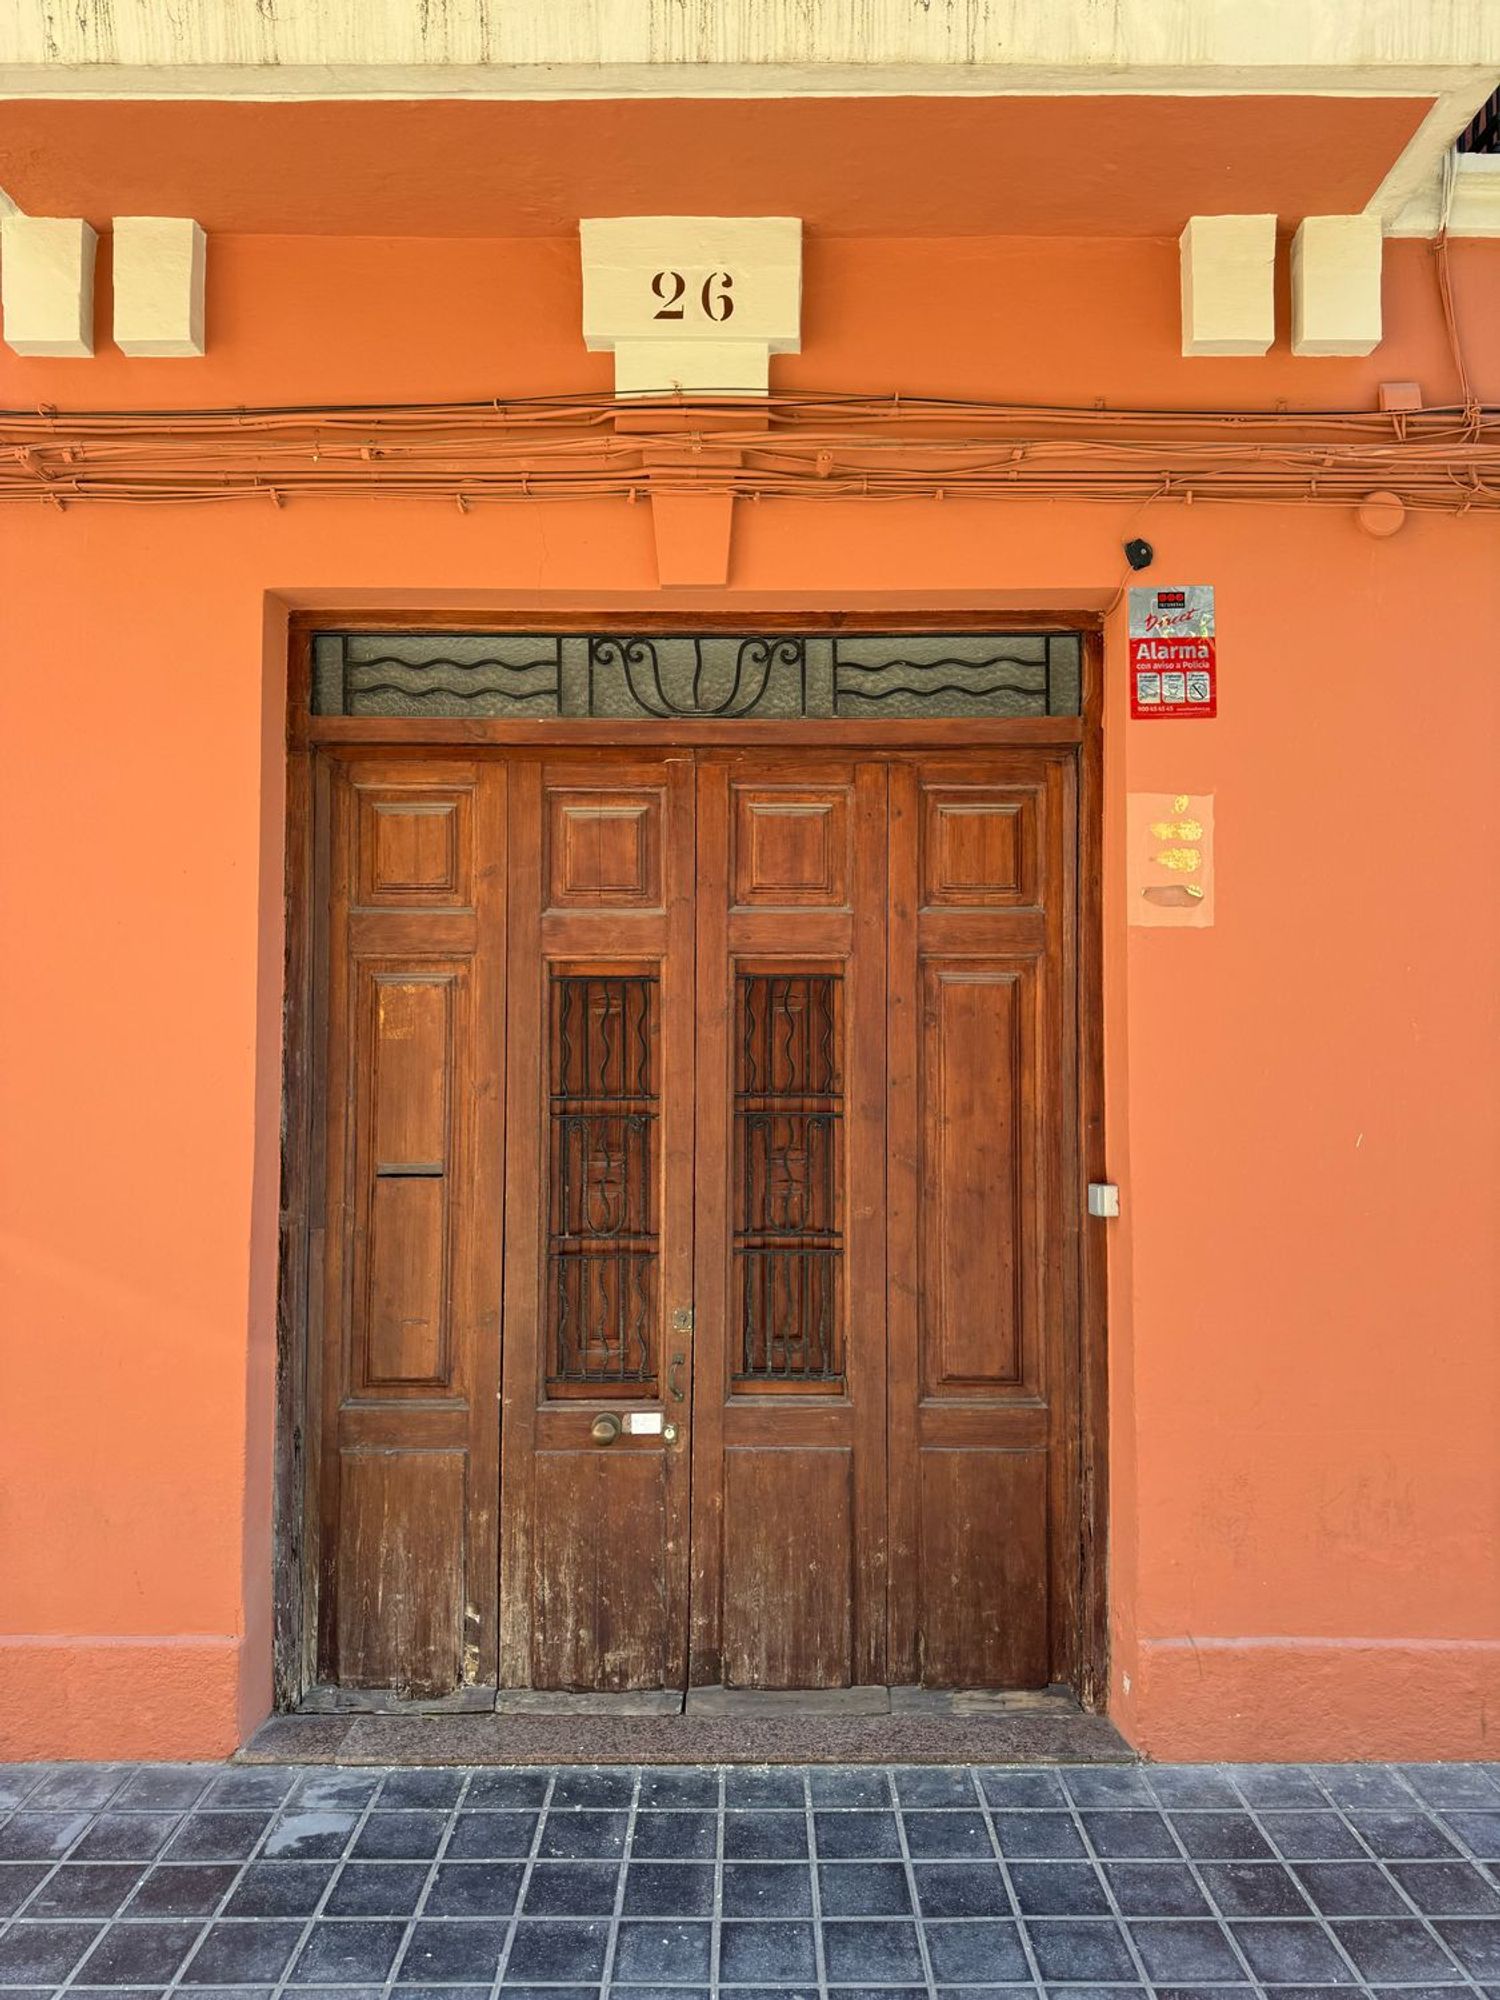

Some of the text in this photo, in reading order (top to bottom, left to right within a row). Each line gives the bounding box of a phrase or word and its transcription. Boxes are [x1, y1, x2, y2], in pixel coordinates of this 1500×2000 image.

[651, 271, 734, 322] 26
[1145, 608, 1198, 631] Direct
[1136, 642, 1209, 660] Alarma
[1153, 661, 1174, 669] aviso
